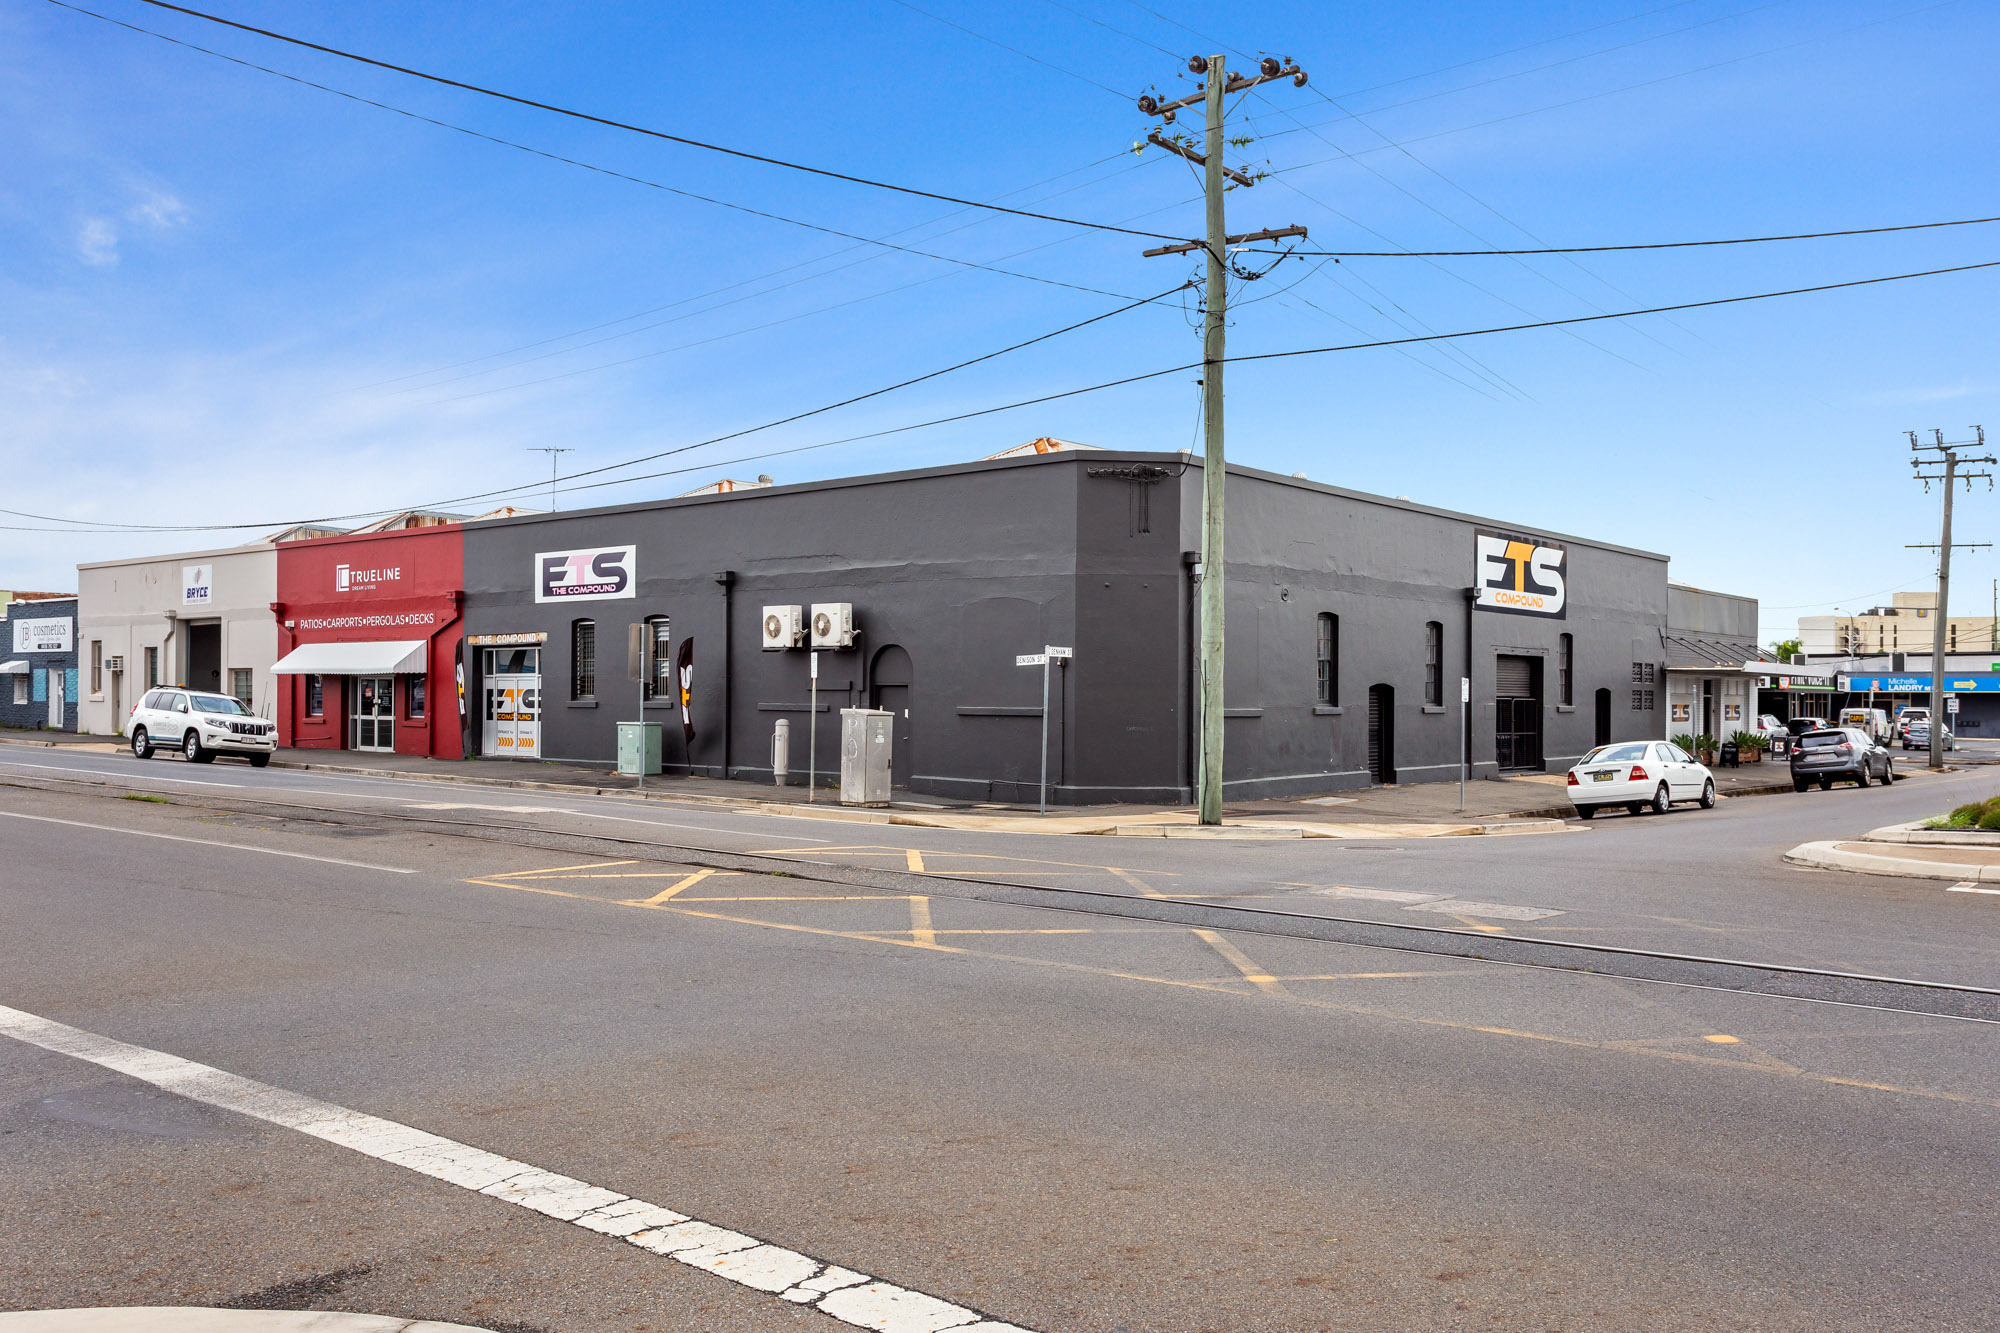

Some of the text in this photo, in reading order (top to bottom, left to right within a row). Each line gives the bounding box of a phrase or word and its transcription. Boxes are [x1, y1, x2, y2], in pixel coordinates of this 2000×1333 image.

[351, 567, 401, 584] TRUELINE
[543, 552, 628, 598] ETS
[1477, 535, 1565, 614] ETS
[187, 586, 209, 599] BRYCE
[552, 584, 617, 596] THE COMPOUND
[1495, 592, 1544, 608] COMPOUND
[33, 621, 67, 636] cosmetics
[300, 613, 435, 629] PATIOS CARPORTS PERGOLAS DECKS
[479, 633, 537, 644] THE COMPOUND
[1017, 656, 1036, 664] DENISON
[1050, 648, 1066, 656] DENHAM
[1672, 704, 1690, 722] ETS
[1725, 704, 1741, 721] ETS
